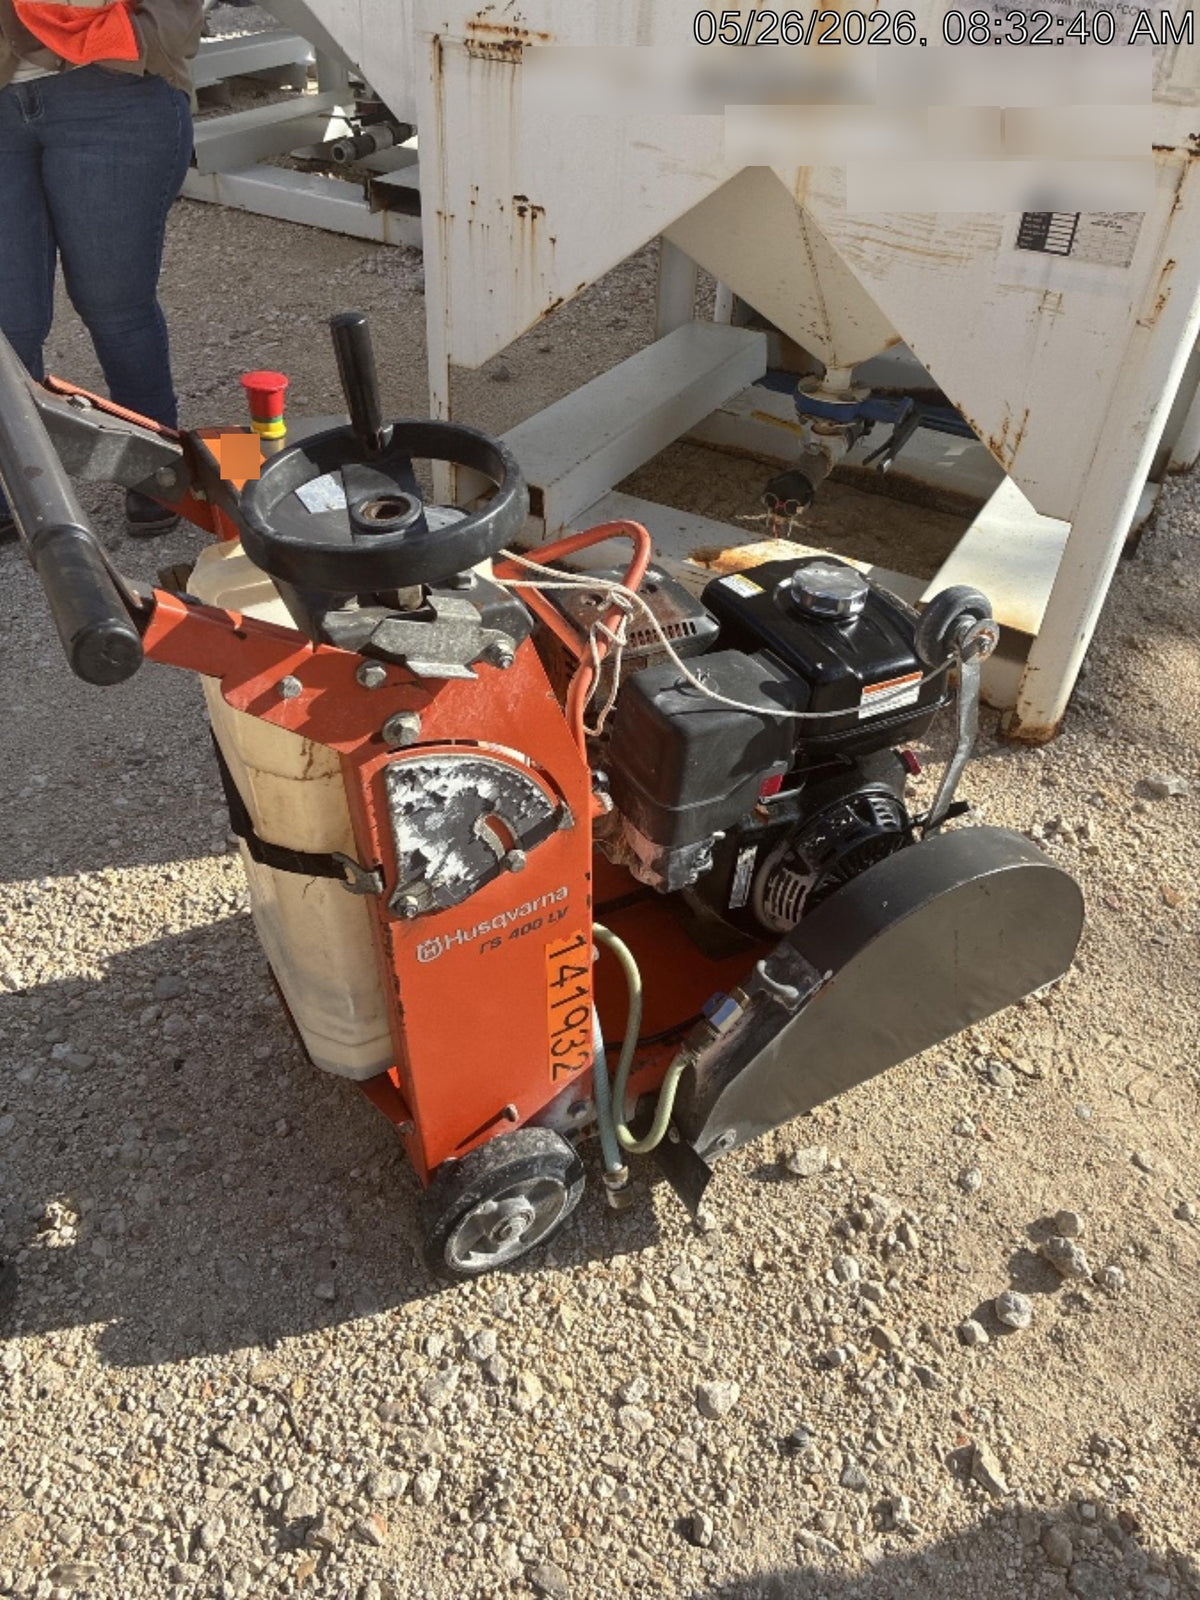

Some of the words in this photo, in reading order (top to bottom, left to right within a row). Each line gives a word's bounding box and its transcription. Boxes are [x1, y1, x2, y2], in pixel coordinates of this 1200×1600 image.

[444, 886, 569, 950] Husqvarna
[508, 918, 543, 940] 400
[548, 906, 569, 924] LV
[549, 934, 589, 1081] 141932
